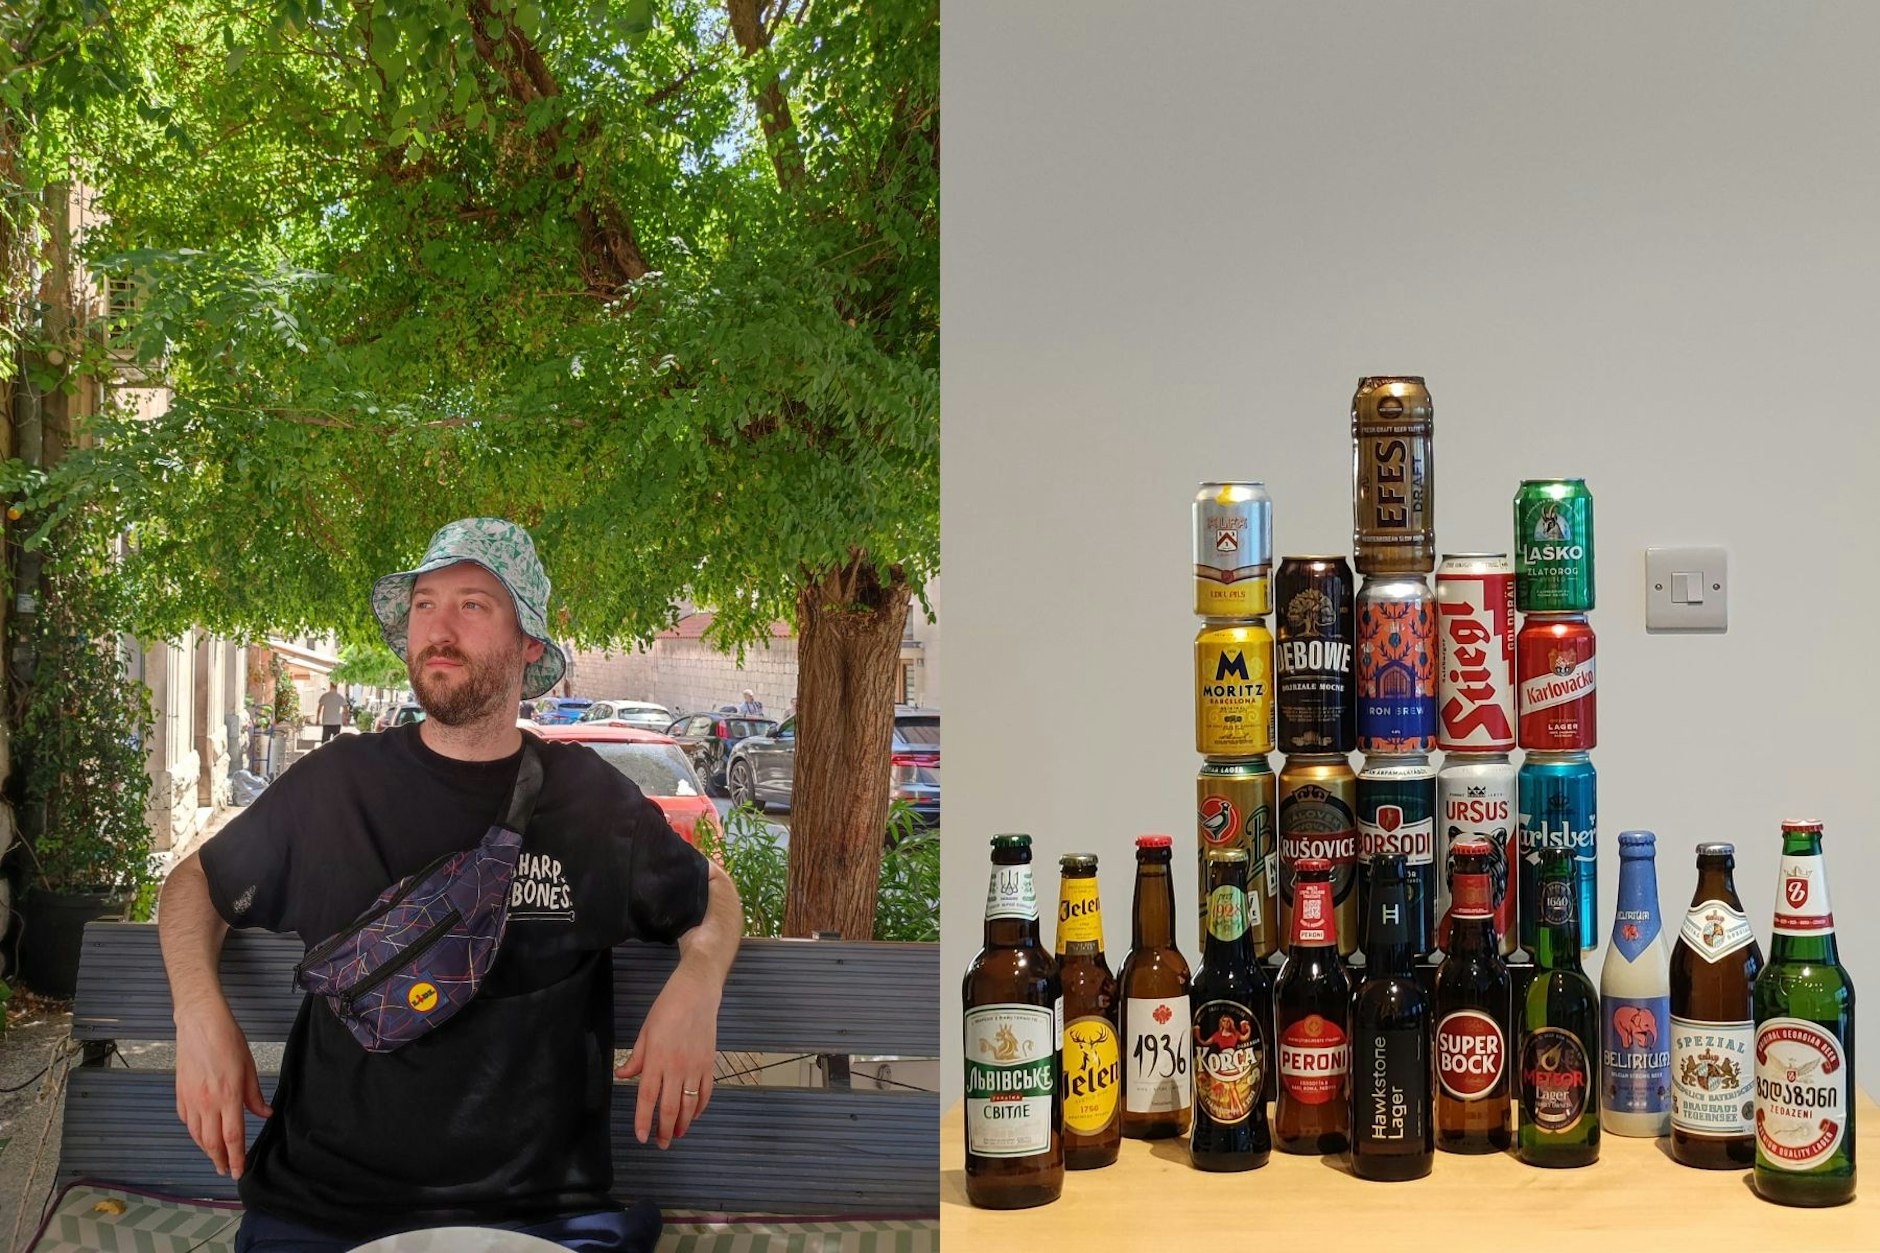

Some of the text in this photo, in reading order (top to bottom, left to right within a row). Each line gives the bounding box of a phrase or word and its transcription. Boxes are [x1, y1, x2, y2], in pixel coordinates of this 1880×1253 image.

[1375, 438, 1409, 529] EFES
[1412, 457, 1423, 512] DRAFT
[1524, 543, 1584, 565] LAŠKO
[1528, 567, 1579, 576] ZLATOROG
[1216, 650, 1250, 680] M
[1278, 640, 1352, 674] DĘBOWE
[1439, 601, 1512, 740] Stiegl
[1203, 684, 1264, 697] MORITZ
[1526, 669, 1594, 705] Karlovačko
[1366, 706, 1424, 716] RON BREW
[1548, 723, 1578, 731] LAGER
[1220, 766, 1244, 774] LAGER
[1446, 800, 1508, 824] URSUS
[1358, 832, 1430, 855] BORSODI
[1519, 814, 1597, 852] arlsber
[511, 853, 562, 884] HARP
[1060, 896, 1100, 922] Jelen
[1547, 896, 1568, 907] 1640
[1300, 931, 1324, 939] PERONI
[1133, 1029, 1187, 1078] 1936
[1440, 1032, 1498, 1054] SUPER
[1676, 1036, 1745, 1054] SPEZIAL
[1758, 1028, 1838, 1063] ORIGINAL GEORGIAN BEER
[1282, 1050, 1346, 1070] PERONI
[1441, 1052, 1497, 1074] BOCK
[1604, 1050, 1670, 1069] DELIRIUM
[966, 1065, 1054, 1093] ЛЬВІВСЬКЕ
[1371, 1036, 1387, 1139] Hawkstone
[1524, 1070, 1584, 1088] METEOR
[1536, 1086, 1570, 1103] Lager
[1708, 1080, 1755, 1102] BAYERISCHE
[1756, 1075, 1837, 1108] ზედაზენი
[984, 1104, 1030, 1120] СВІТЛЕ
[1388, 1086, 1408, 1139] Lager
[1683, 1101, 1738, 1112] BRAUHAUS
[1684, 1111, 1738, 1122] TEGERNSEE
[1770, 1105, 1813, 1119] ZEDAZENI
[1758, 1122, 1834, 1159] PREMIUM QUALITY LAGER
